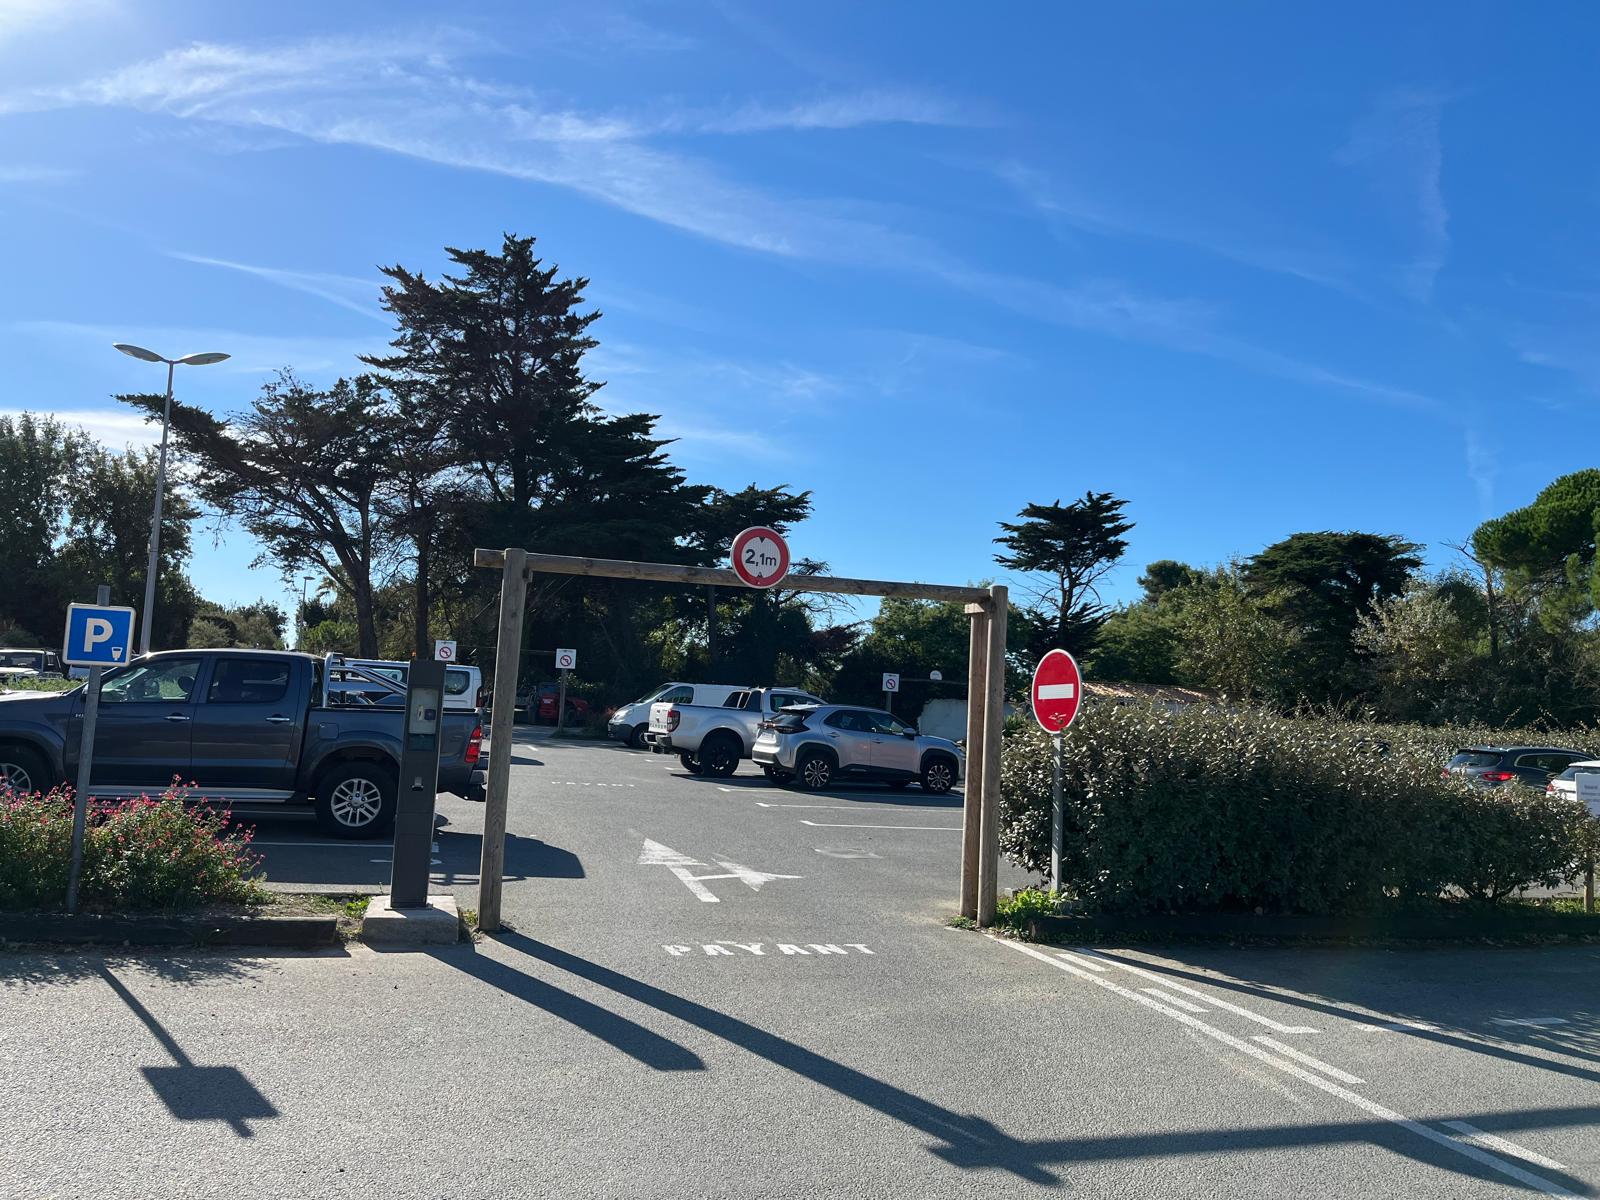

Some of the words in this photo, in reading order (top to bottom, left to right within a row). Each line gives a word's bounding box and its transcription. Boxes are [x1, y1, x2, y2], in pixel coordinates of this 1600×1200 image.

[745, 549, 777, 567] 2,1m
[84, 618, 113, 652] P
[661, 943, 875, 956] PAYANT
